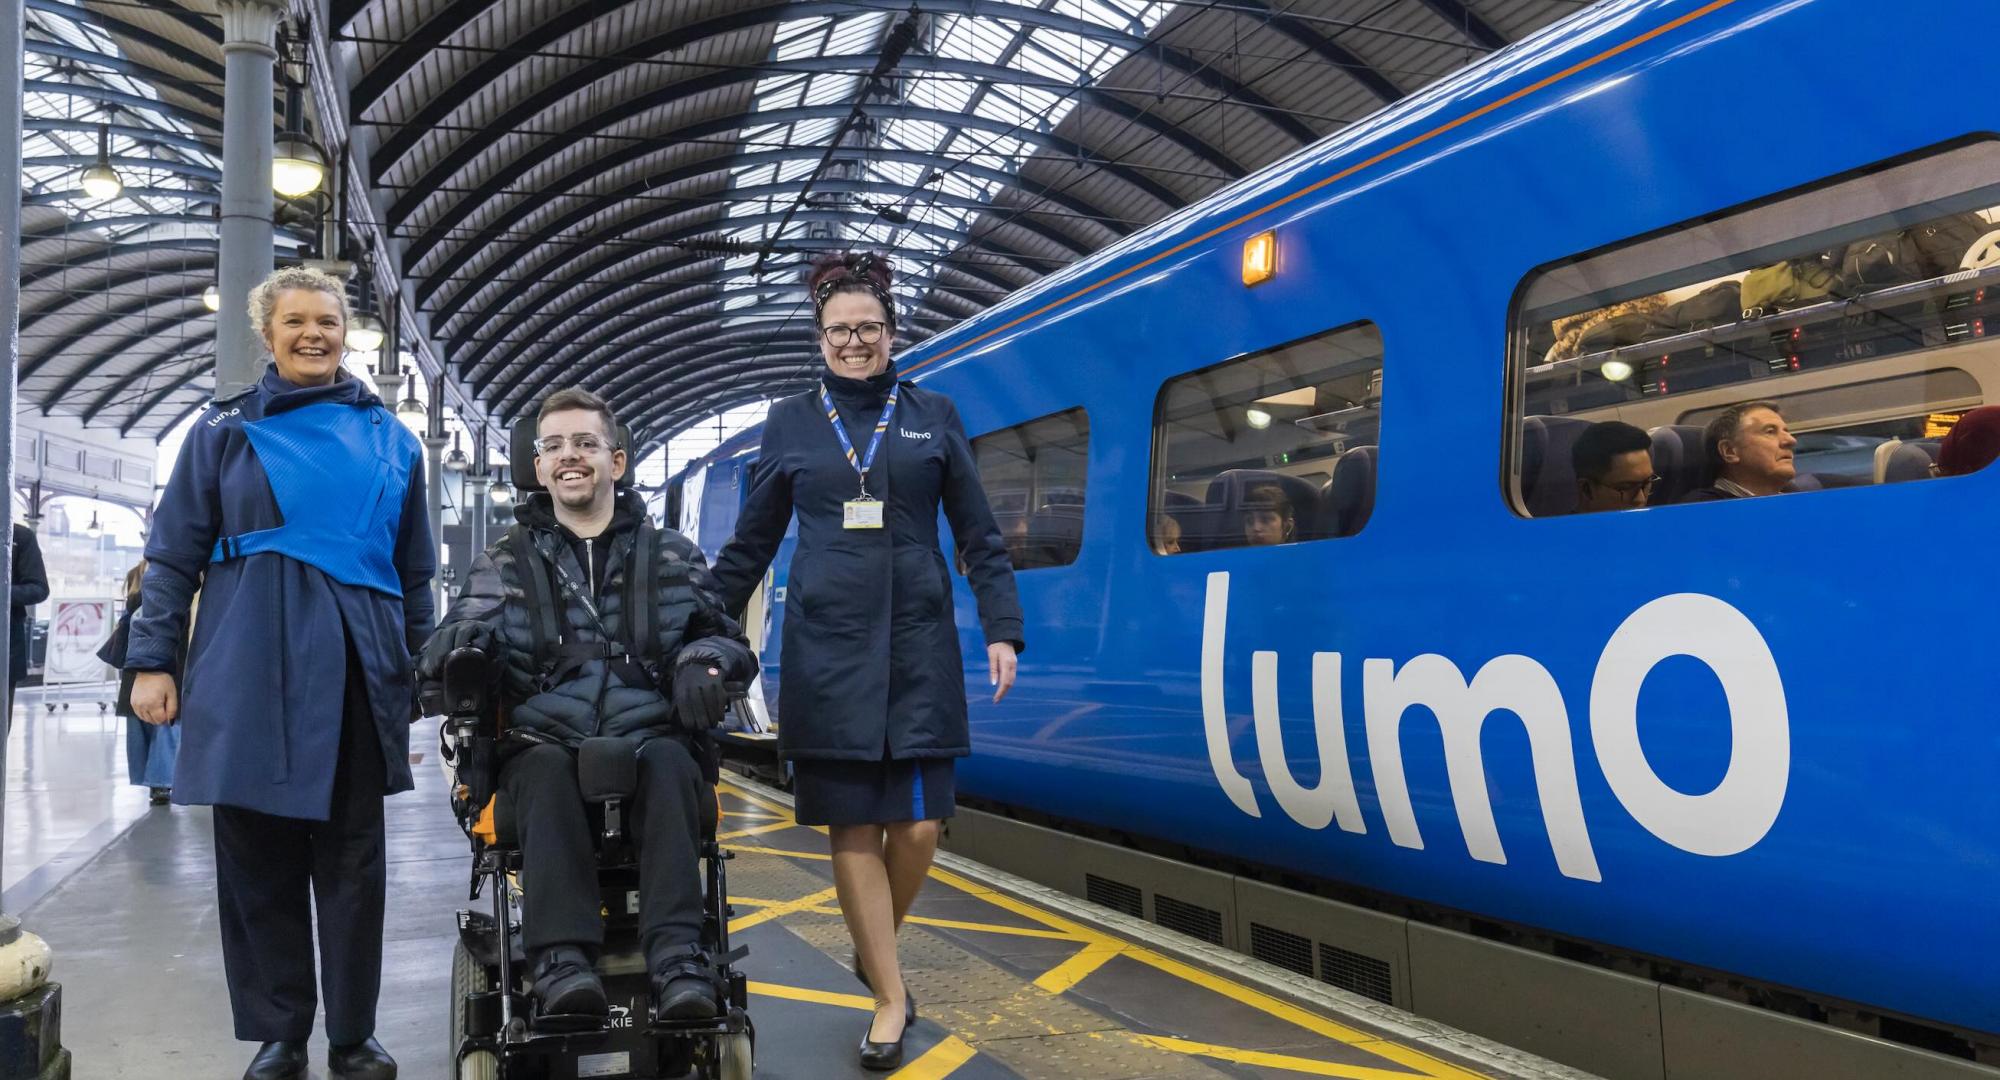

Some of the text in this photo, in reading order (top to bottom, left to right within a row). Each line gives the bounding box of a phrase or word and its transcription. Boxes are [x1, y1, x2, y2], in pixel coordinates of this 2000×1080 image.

[207, 408, 240, 427] lumo
[900, 427, 932, 440] lumo
[1201, 571, 1790, 883] lumo
